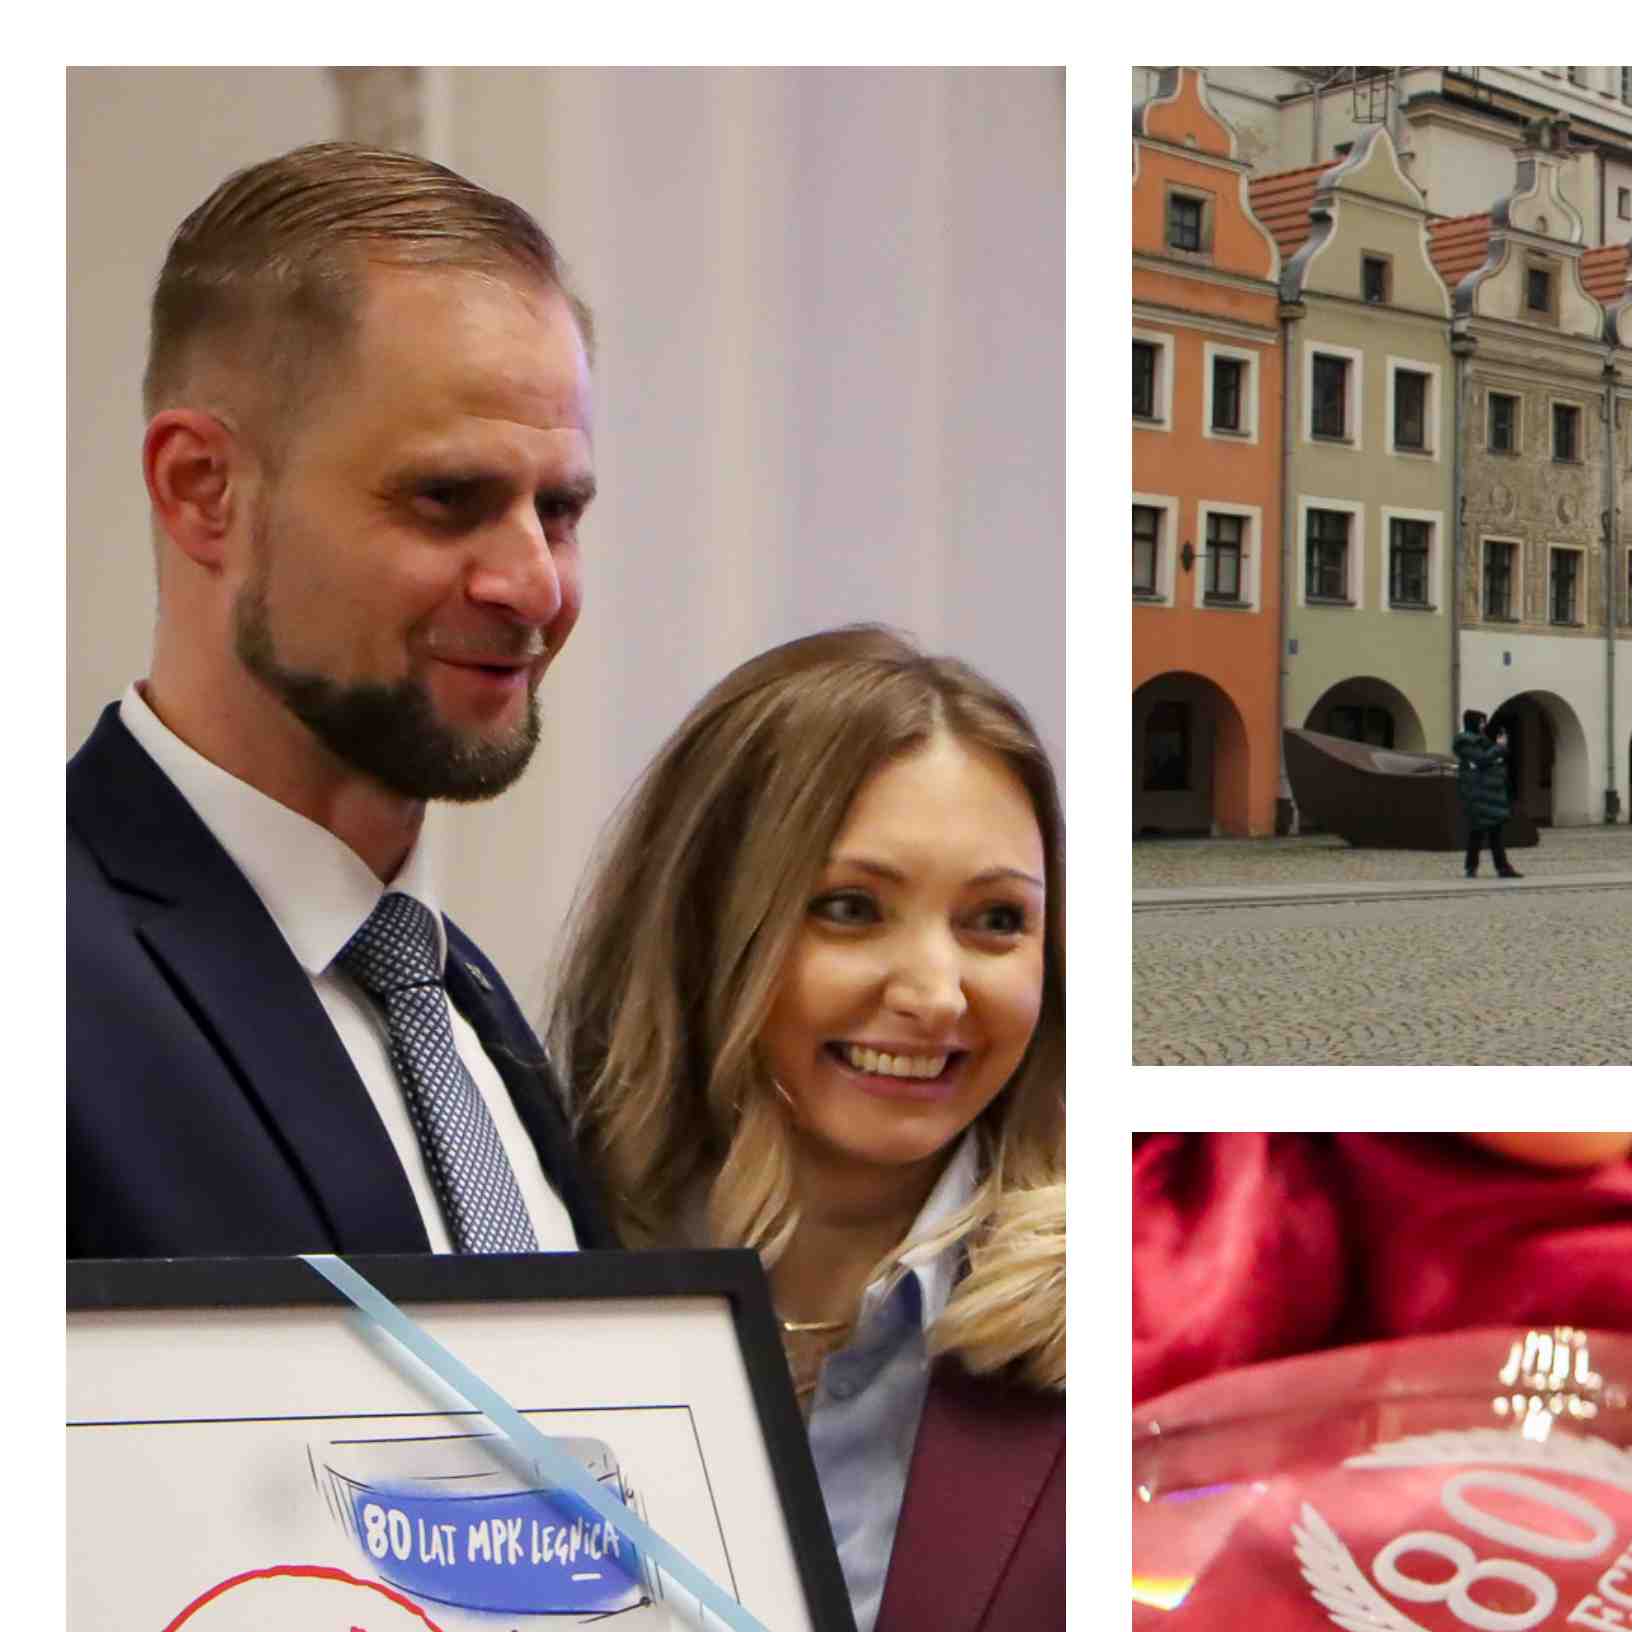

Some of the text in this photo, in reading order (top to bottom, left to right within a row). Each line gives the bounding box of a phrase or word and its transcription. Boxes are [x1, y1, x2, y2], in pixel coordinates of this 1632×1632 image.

[363, 1503, 412, 1561] 80
[418, 1518, 457, 1567] LAT
[467, 1517, 525, 1566] MPK
